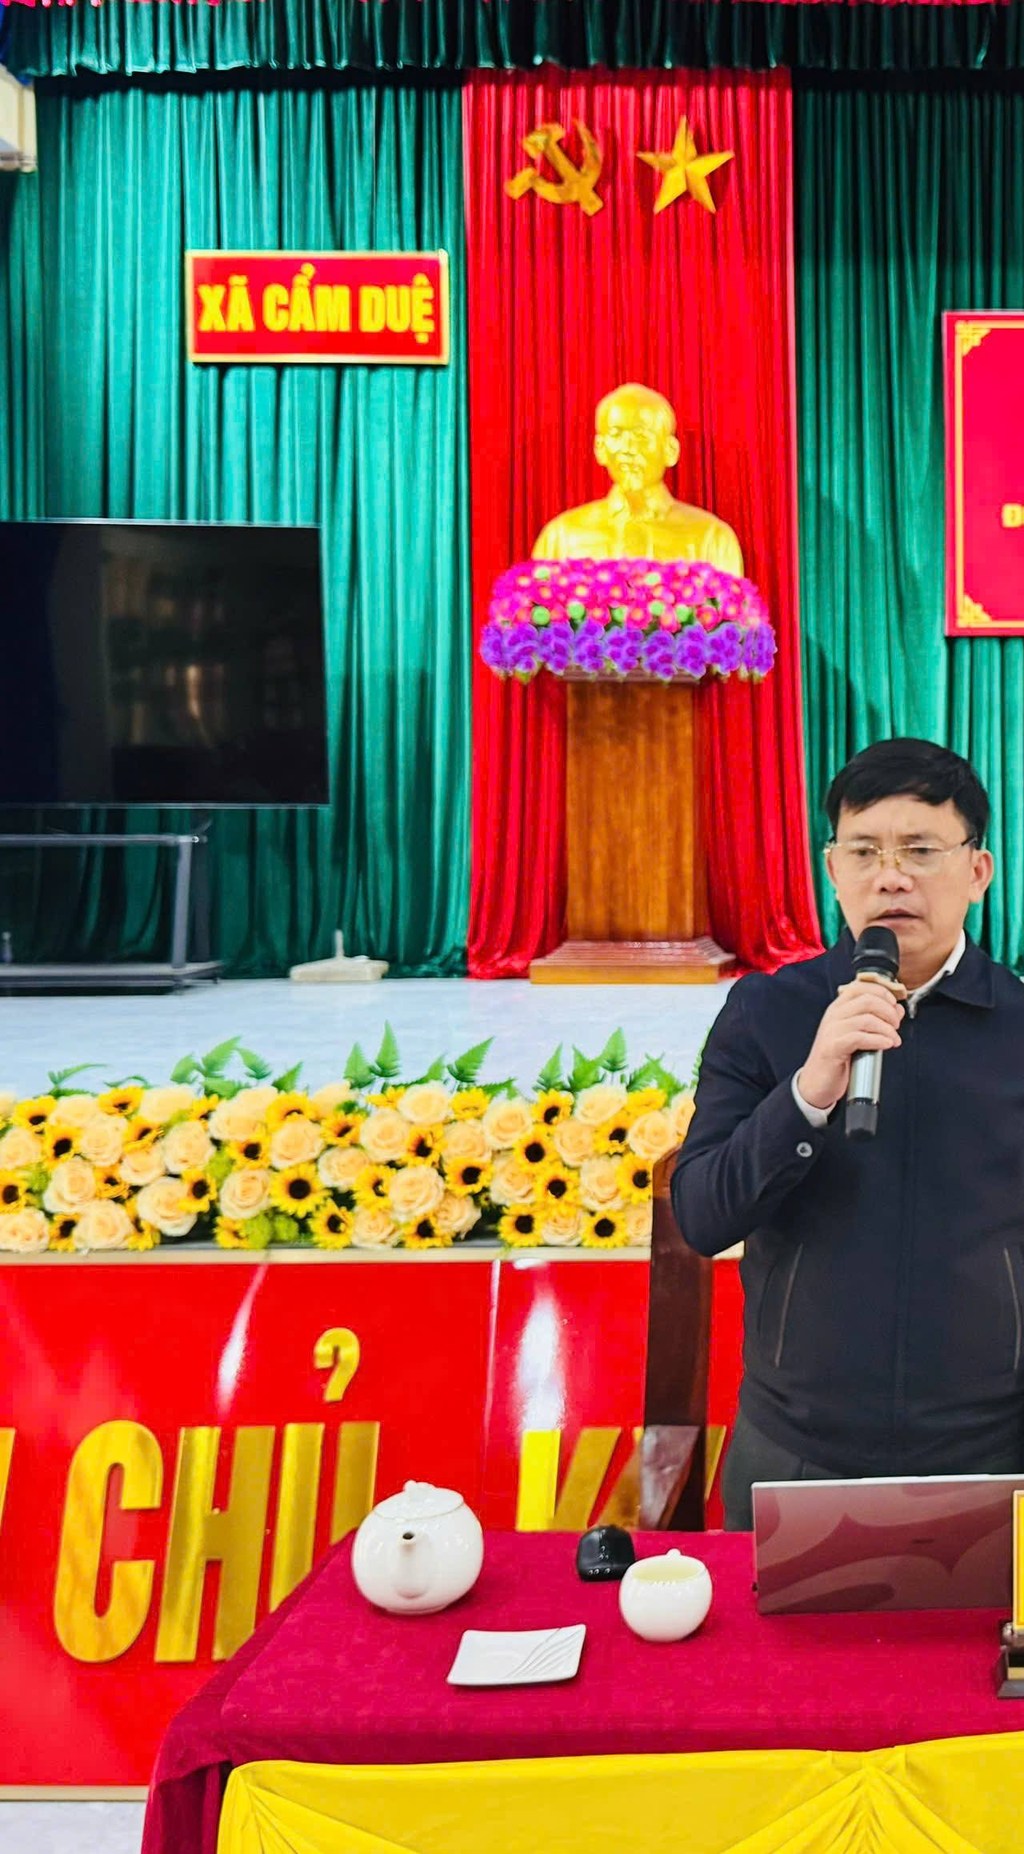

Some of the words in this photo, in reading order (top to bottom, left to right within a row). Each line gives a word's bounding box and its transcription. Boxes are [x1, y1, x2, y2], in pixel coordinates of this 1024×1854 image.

[198, 275, 255, 332] XÃ
[263, 262, 351, 332] CẨM
[359, 273, 435, 343] DUỆ
